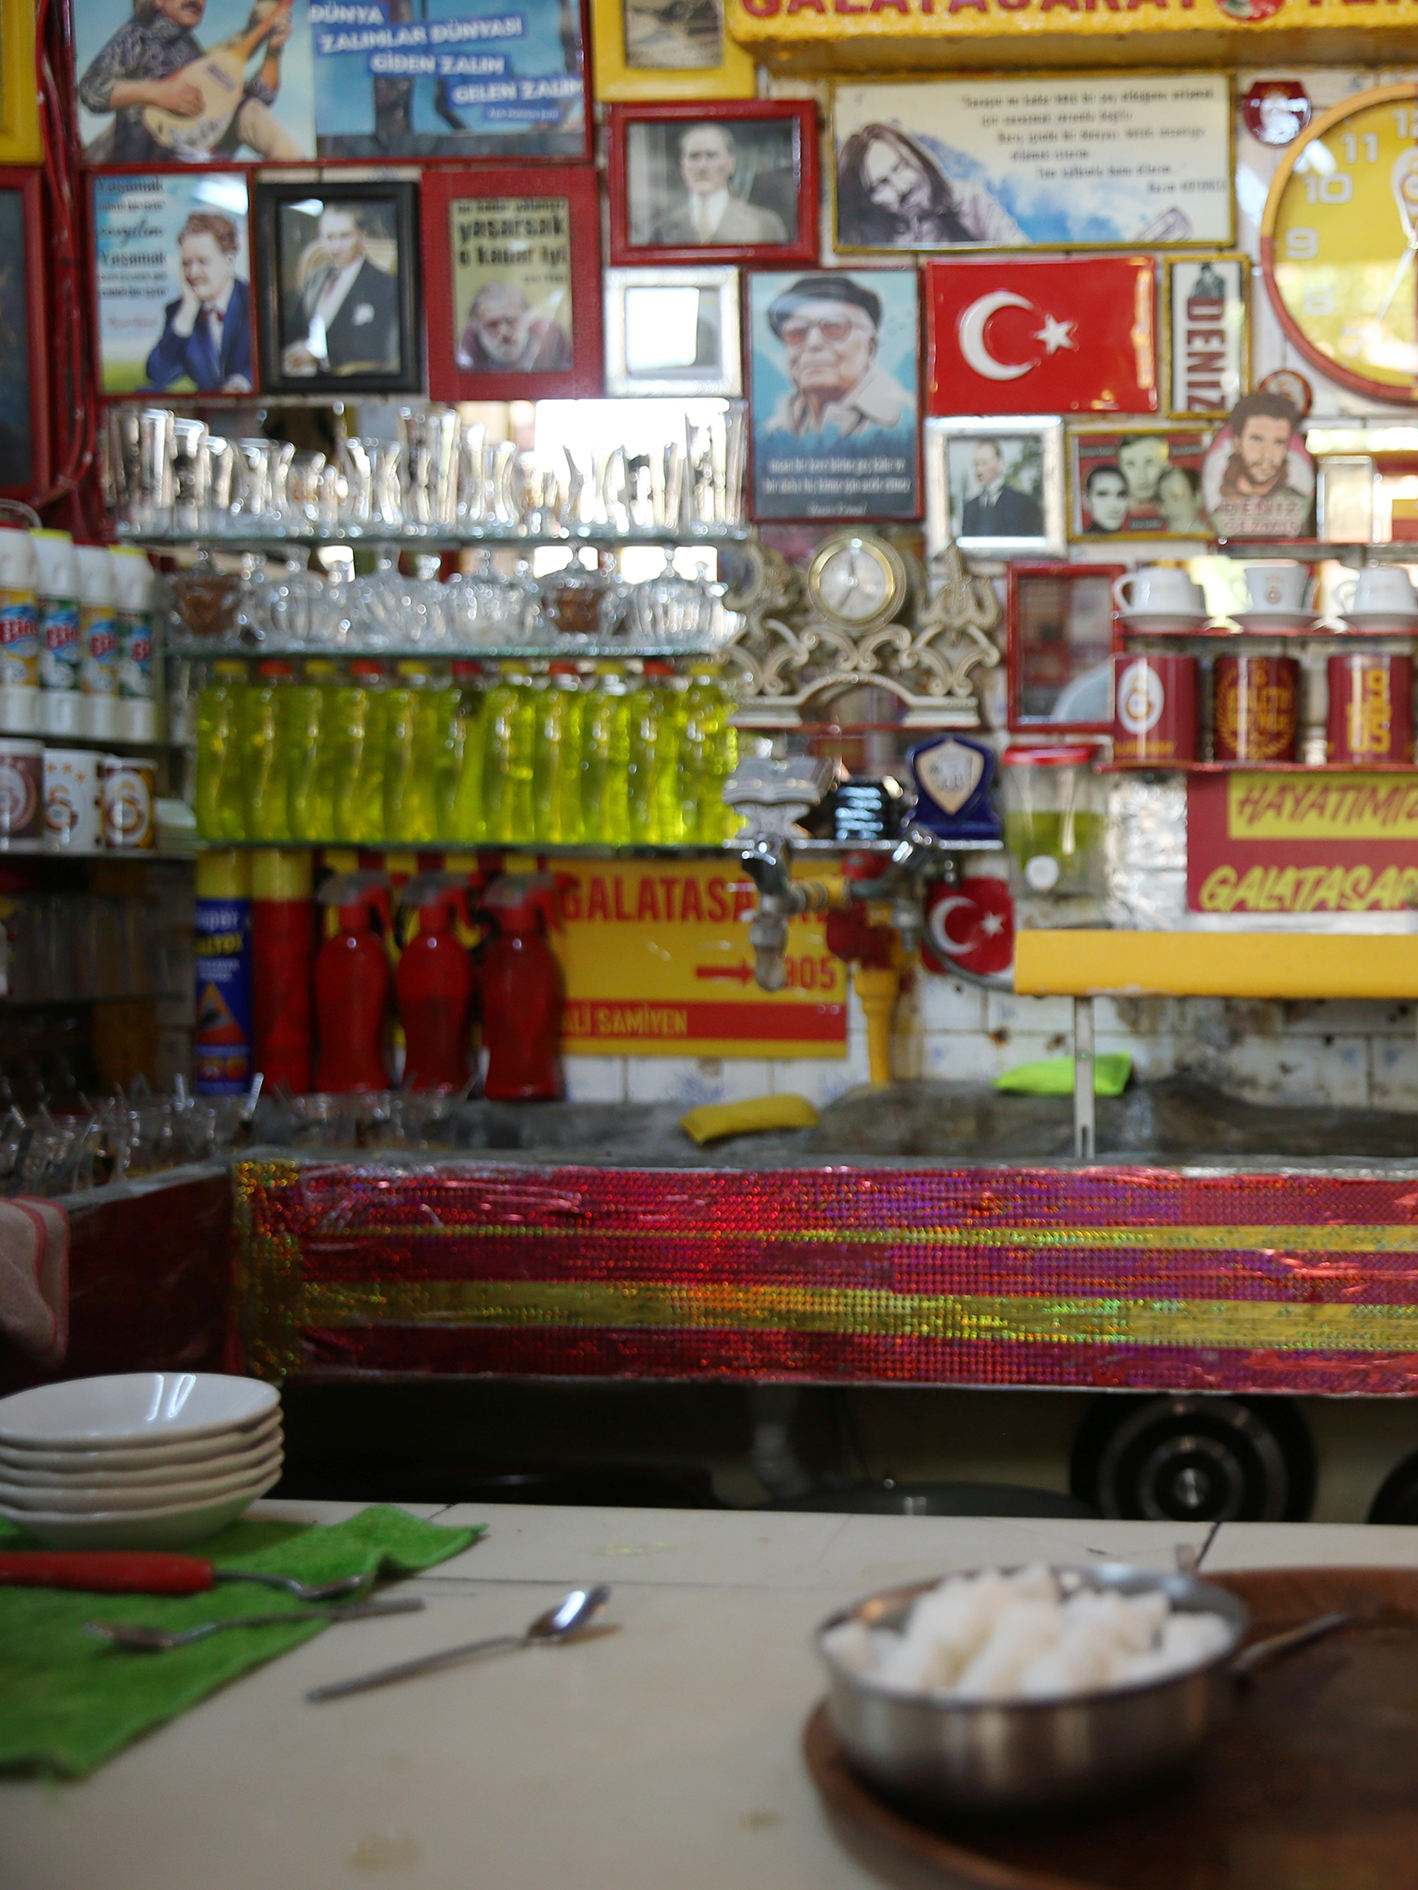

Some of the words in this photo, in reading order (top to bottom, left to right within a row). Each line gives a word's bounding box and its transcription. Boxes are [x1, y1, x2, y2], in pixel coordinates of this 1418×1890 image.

[309, 2, 384, 25] DÜNYA
[1340, 132, 1379, 164] 11
[1304, 173, 1353, 204] 10
[1285, 227, 1318, 260] 9
